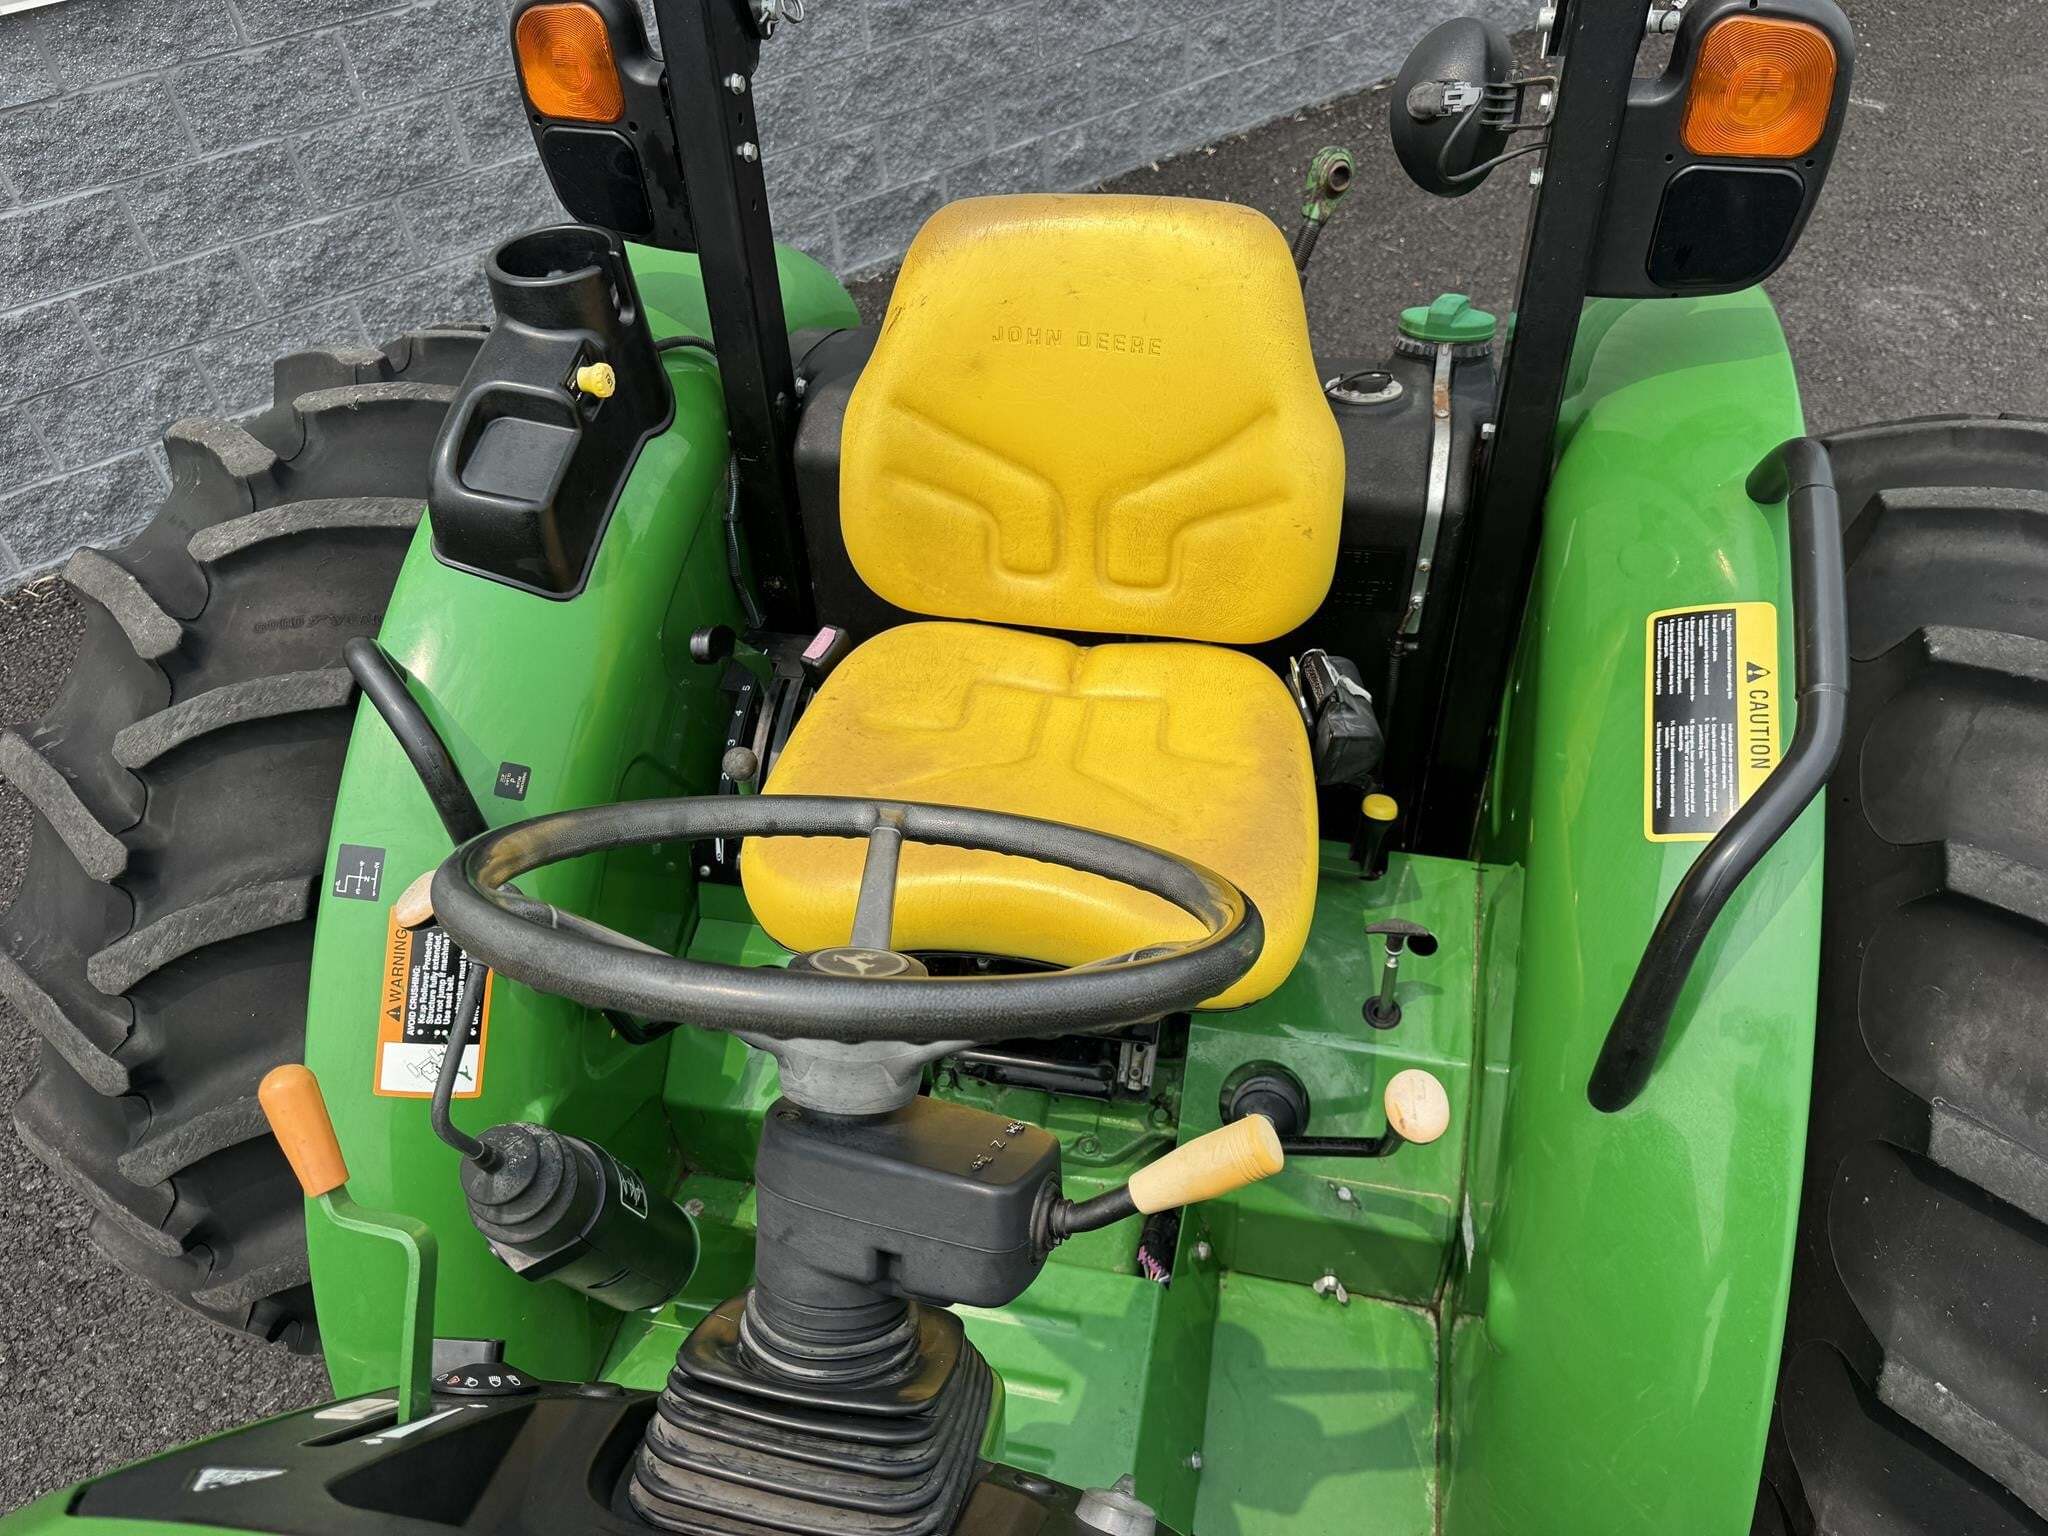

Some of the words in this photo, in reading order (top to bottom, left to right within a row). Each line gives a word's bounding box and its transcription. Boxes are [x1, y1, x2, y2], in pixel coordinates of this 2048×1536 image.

[991, 326, 1062, 346] JOHN
[1076, 331, 1163, 356] DEERE
[1749, 690, 1771, 769] CAUTION
[388, 929, 408, 1003] WARNING
[422, 932, 434, 971] Protective
[432, 933, 443, 971] extended.
[440, 938, 450, 971] machine
[429, 971, 439, 988] fully
[459, 960, 467, 979] must
[408, 965, 421, 1010] CRUSHING:
[420, 971, 430, 1004] Rollover
[437, 979, 447, 999] jump
[426, 988, 436, 1025] Structure
[434, 1012, 442, 1025] Do
[436, 999, 444, 1012] not
[406, 1012, 417, 1036] AVOID
